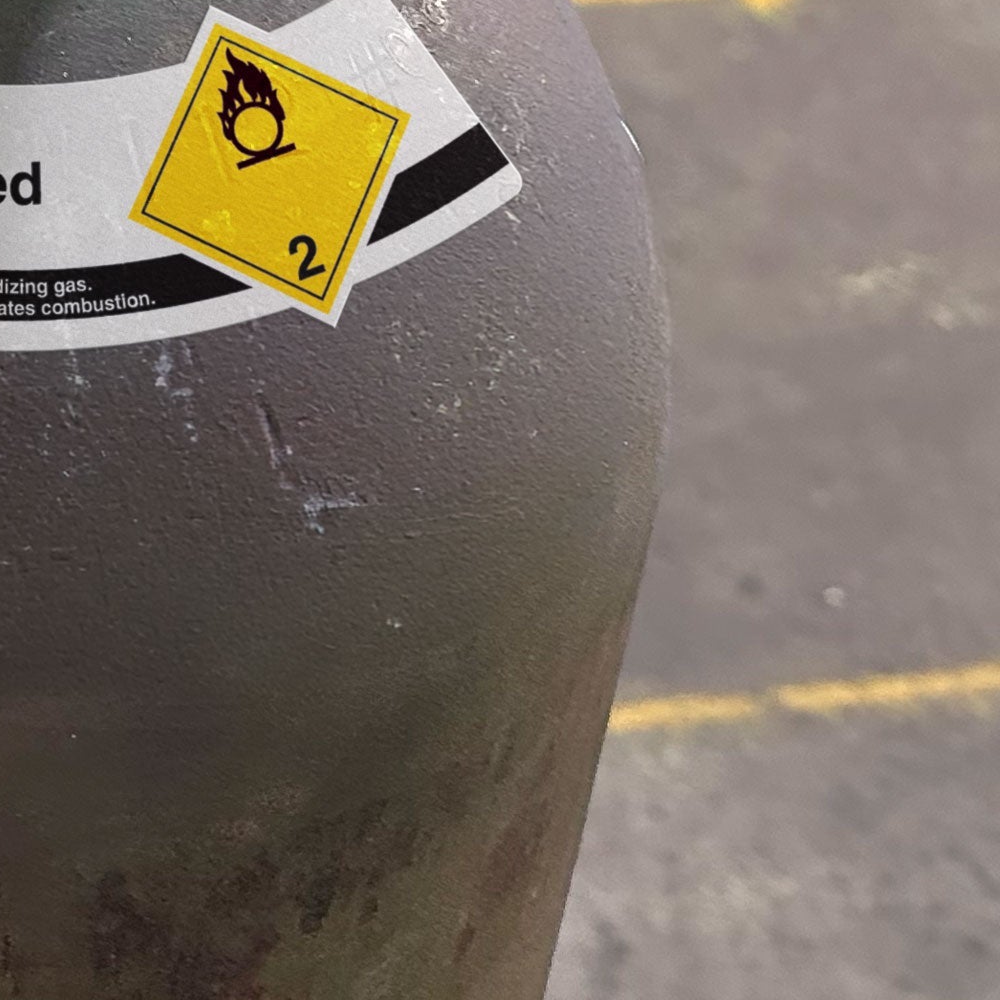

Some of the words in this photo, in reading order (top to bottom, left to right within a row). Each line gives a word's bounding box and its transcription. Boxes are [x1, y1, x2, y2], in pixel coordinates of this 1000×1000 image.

[288, 234, 327, 281] 2
[54, 277, 93, 297] gas.
[41, 293, 156, 316] combustion.
